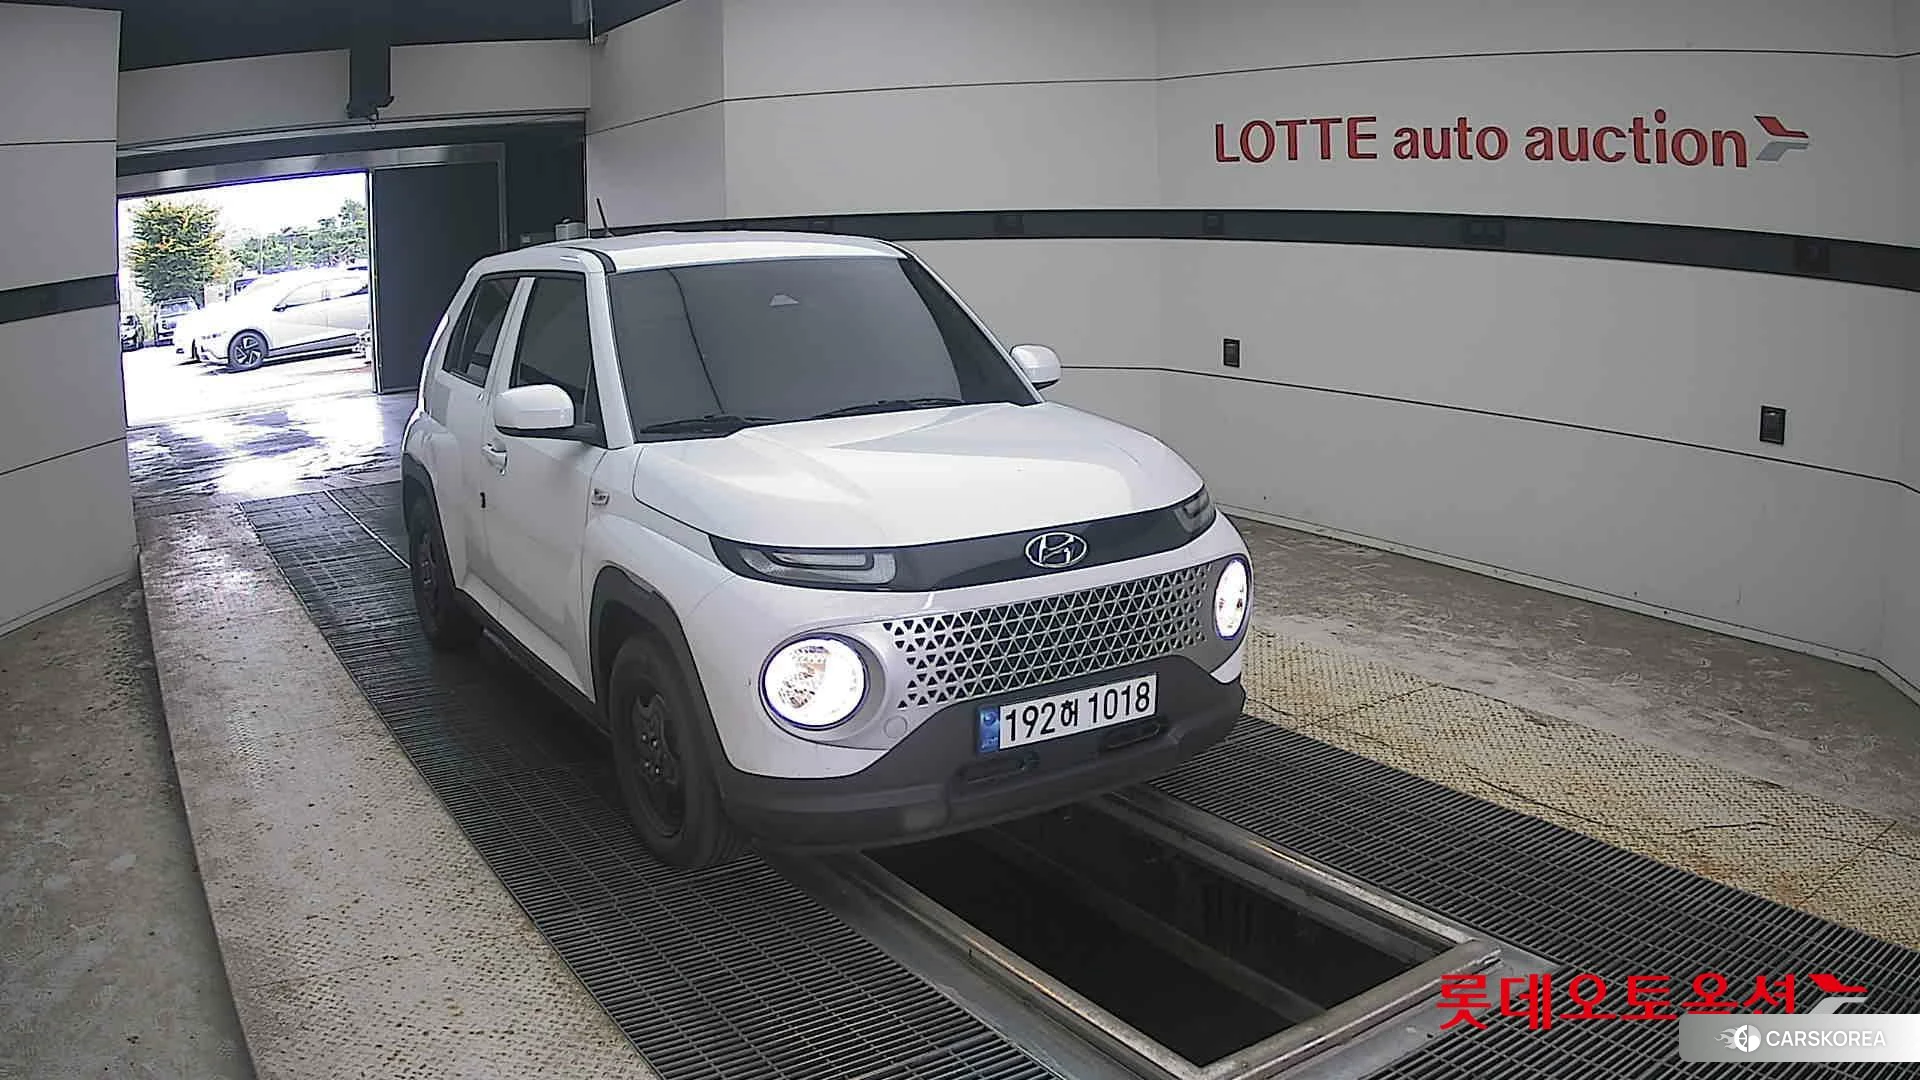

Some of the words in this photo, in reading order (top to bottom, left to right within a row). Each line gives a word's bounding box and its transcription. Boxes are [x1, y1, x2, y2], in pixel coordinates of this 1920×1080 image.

[1215, 116, 1377, 163] LOTTE
[1393, 117, 1508, 162] auto
[1524, 109, 1748, 167] auction
[1005, 698, 1079, 742] 192허
[1088, 681, 1150, 724] 1018
